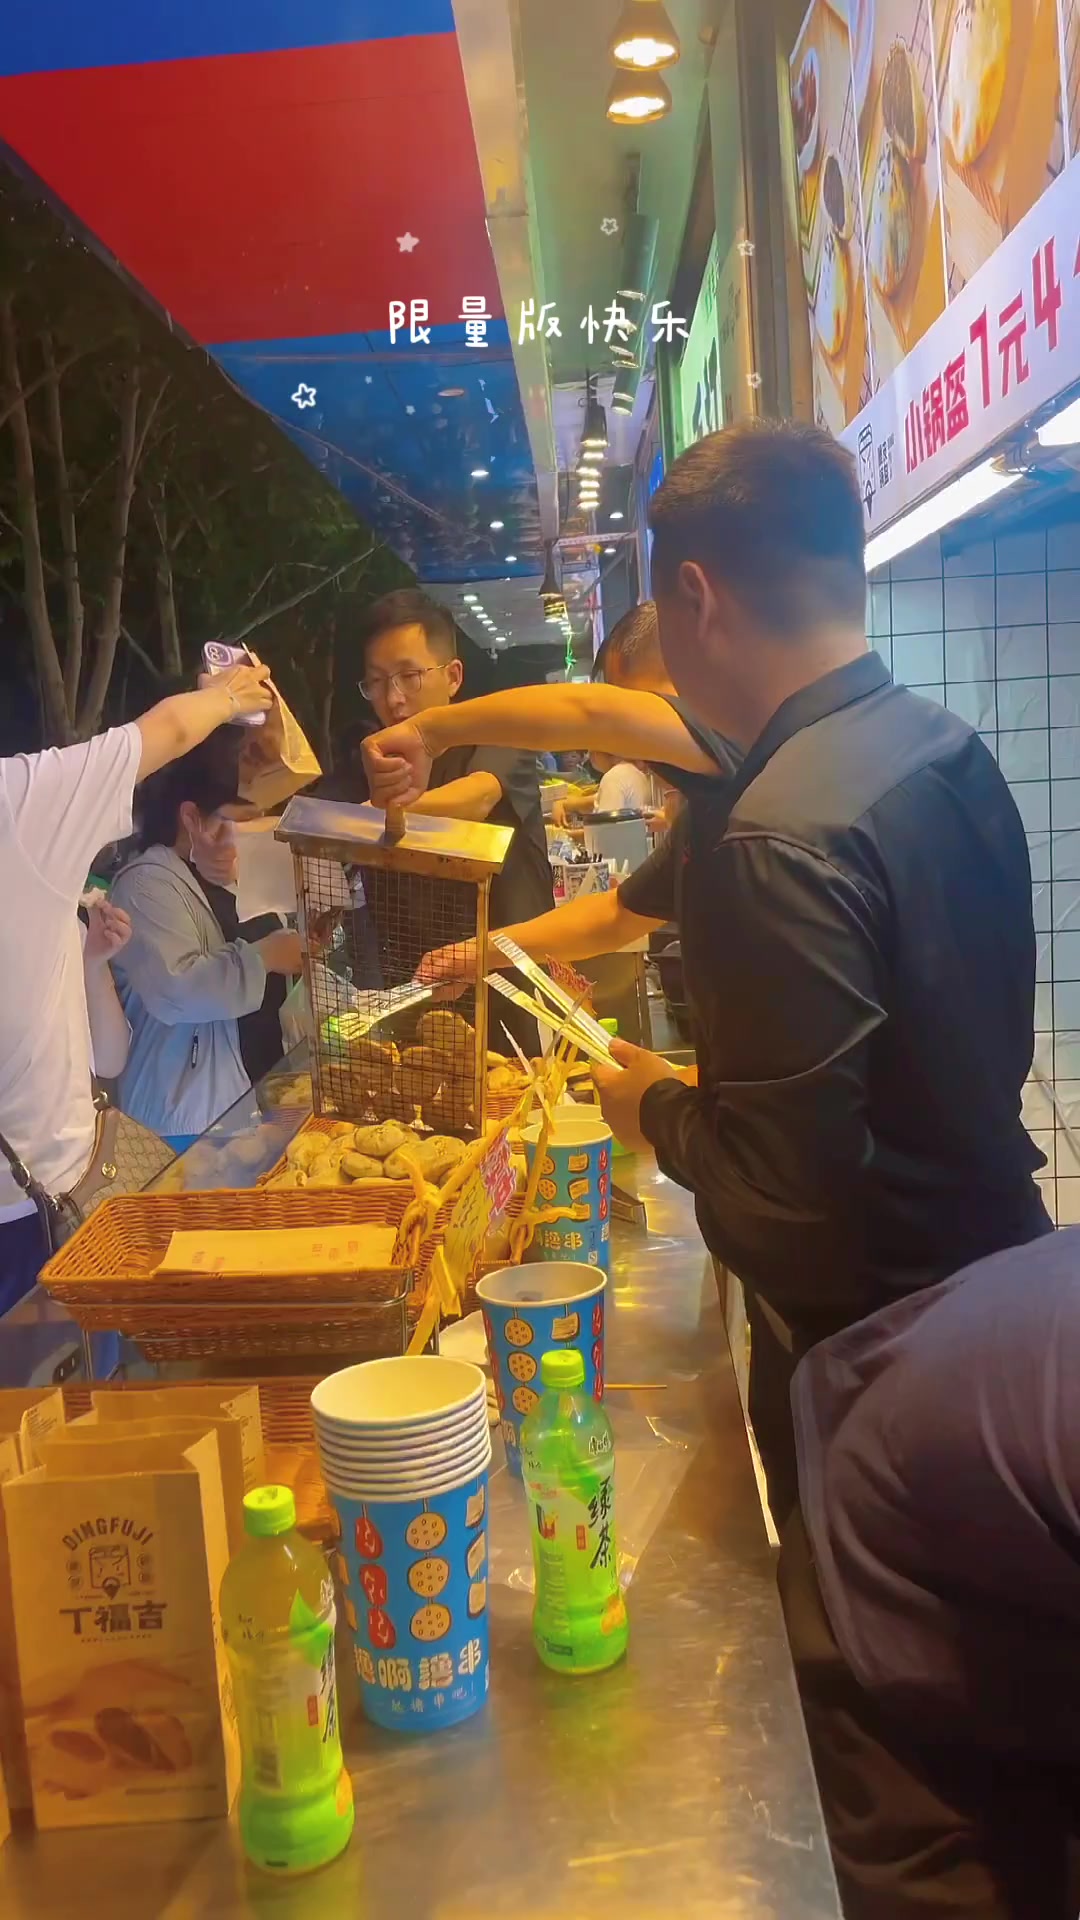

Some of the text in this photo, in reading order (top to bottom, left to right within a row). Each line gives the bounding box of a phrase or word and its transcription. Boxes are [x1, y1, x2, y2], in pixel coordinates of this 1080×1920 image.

[904, 233, 1080, 475] 小锅盔1元4
[62, 1517, 154, 1551] DINGFUJI
[587, 1475, 612, 1570] 绿茶
[59, 1600, 168, 1636] 丁福吉
